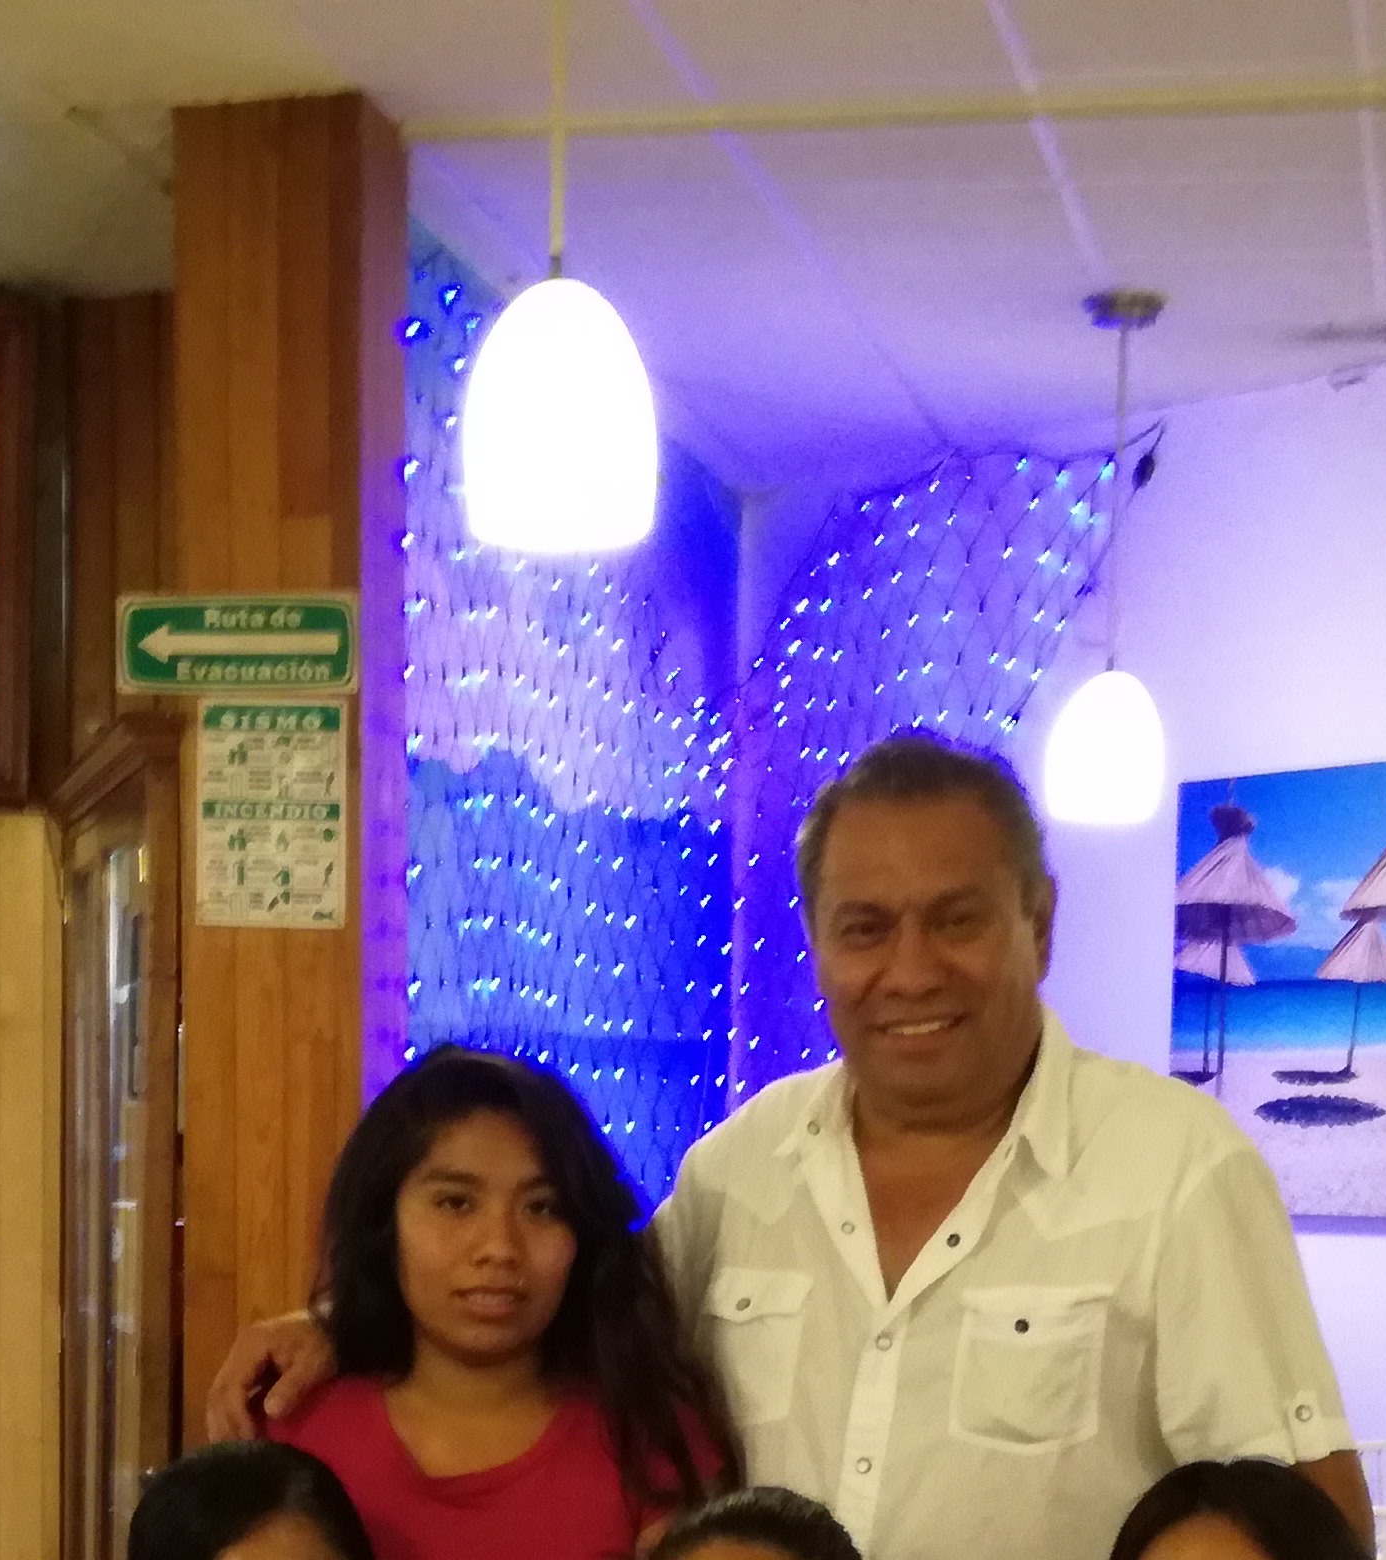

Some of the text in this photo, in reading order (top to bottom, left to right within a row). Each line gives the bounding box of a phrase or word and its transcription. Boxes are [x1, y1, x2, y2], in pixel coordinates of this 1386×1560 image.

[204, 607, 303, 629] Ruta de
[176, 658, 331, 682] Evacuación
[220, 711, 322, 730] SISMO
[214, 803, 328, 821] INCENDIO
